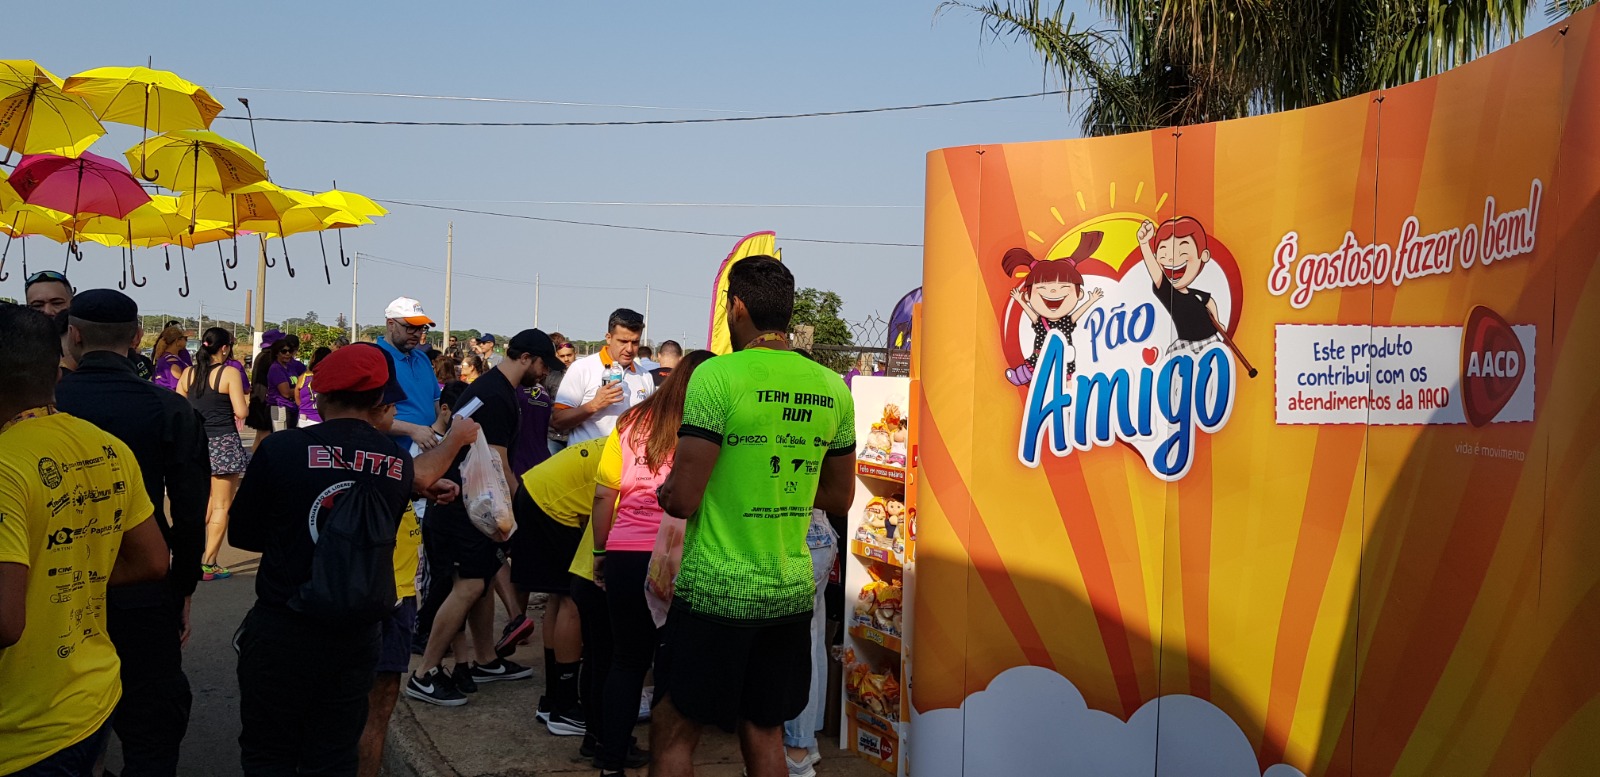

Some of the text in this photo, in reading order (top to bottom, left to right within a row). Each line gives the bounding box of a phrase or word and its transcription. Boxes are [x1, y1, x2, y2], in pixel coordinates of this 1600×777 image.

[1271, 183, 1540, 304] É gostoso fazer o bem!
[1084, 302, 1155, 362] Pão
[1313, 333, 1413, 364] Este produto
[1297, 364, 1428, 386] contribui com os
[1467, 350, 1520, 378] AACD
[756, 390, 834, 409] TEAM BRABO
[1022, 333, 1231, 476] Amigo
[1288, 387, 1450, 411] atendimentos da AACD
[782, 407, 813, 422] RUN
[308, 445, 404, 480] ELITE
[1455, 441, 1525, 462] vida é movimento
